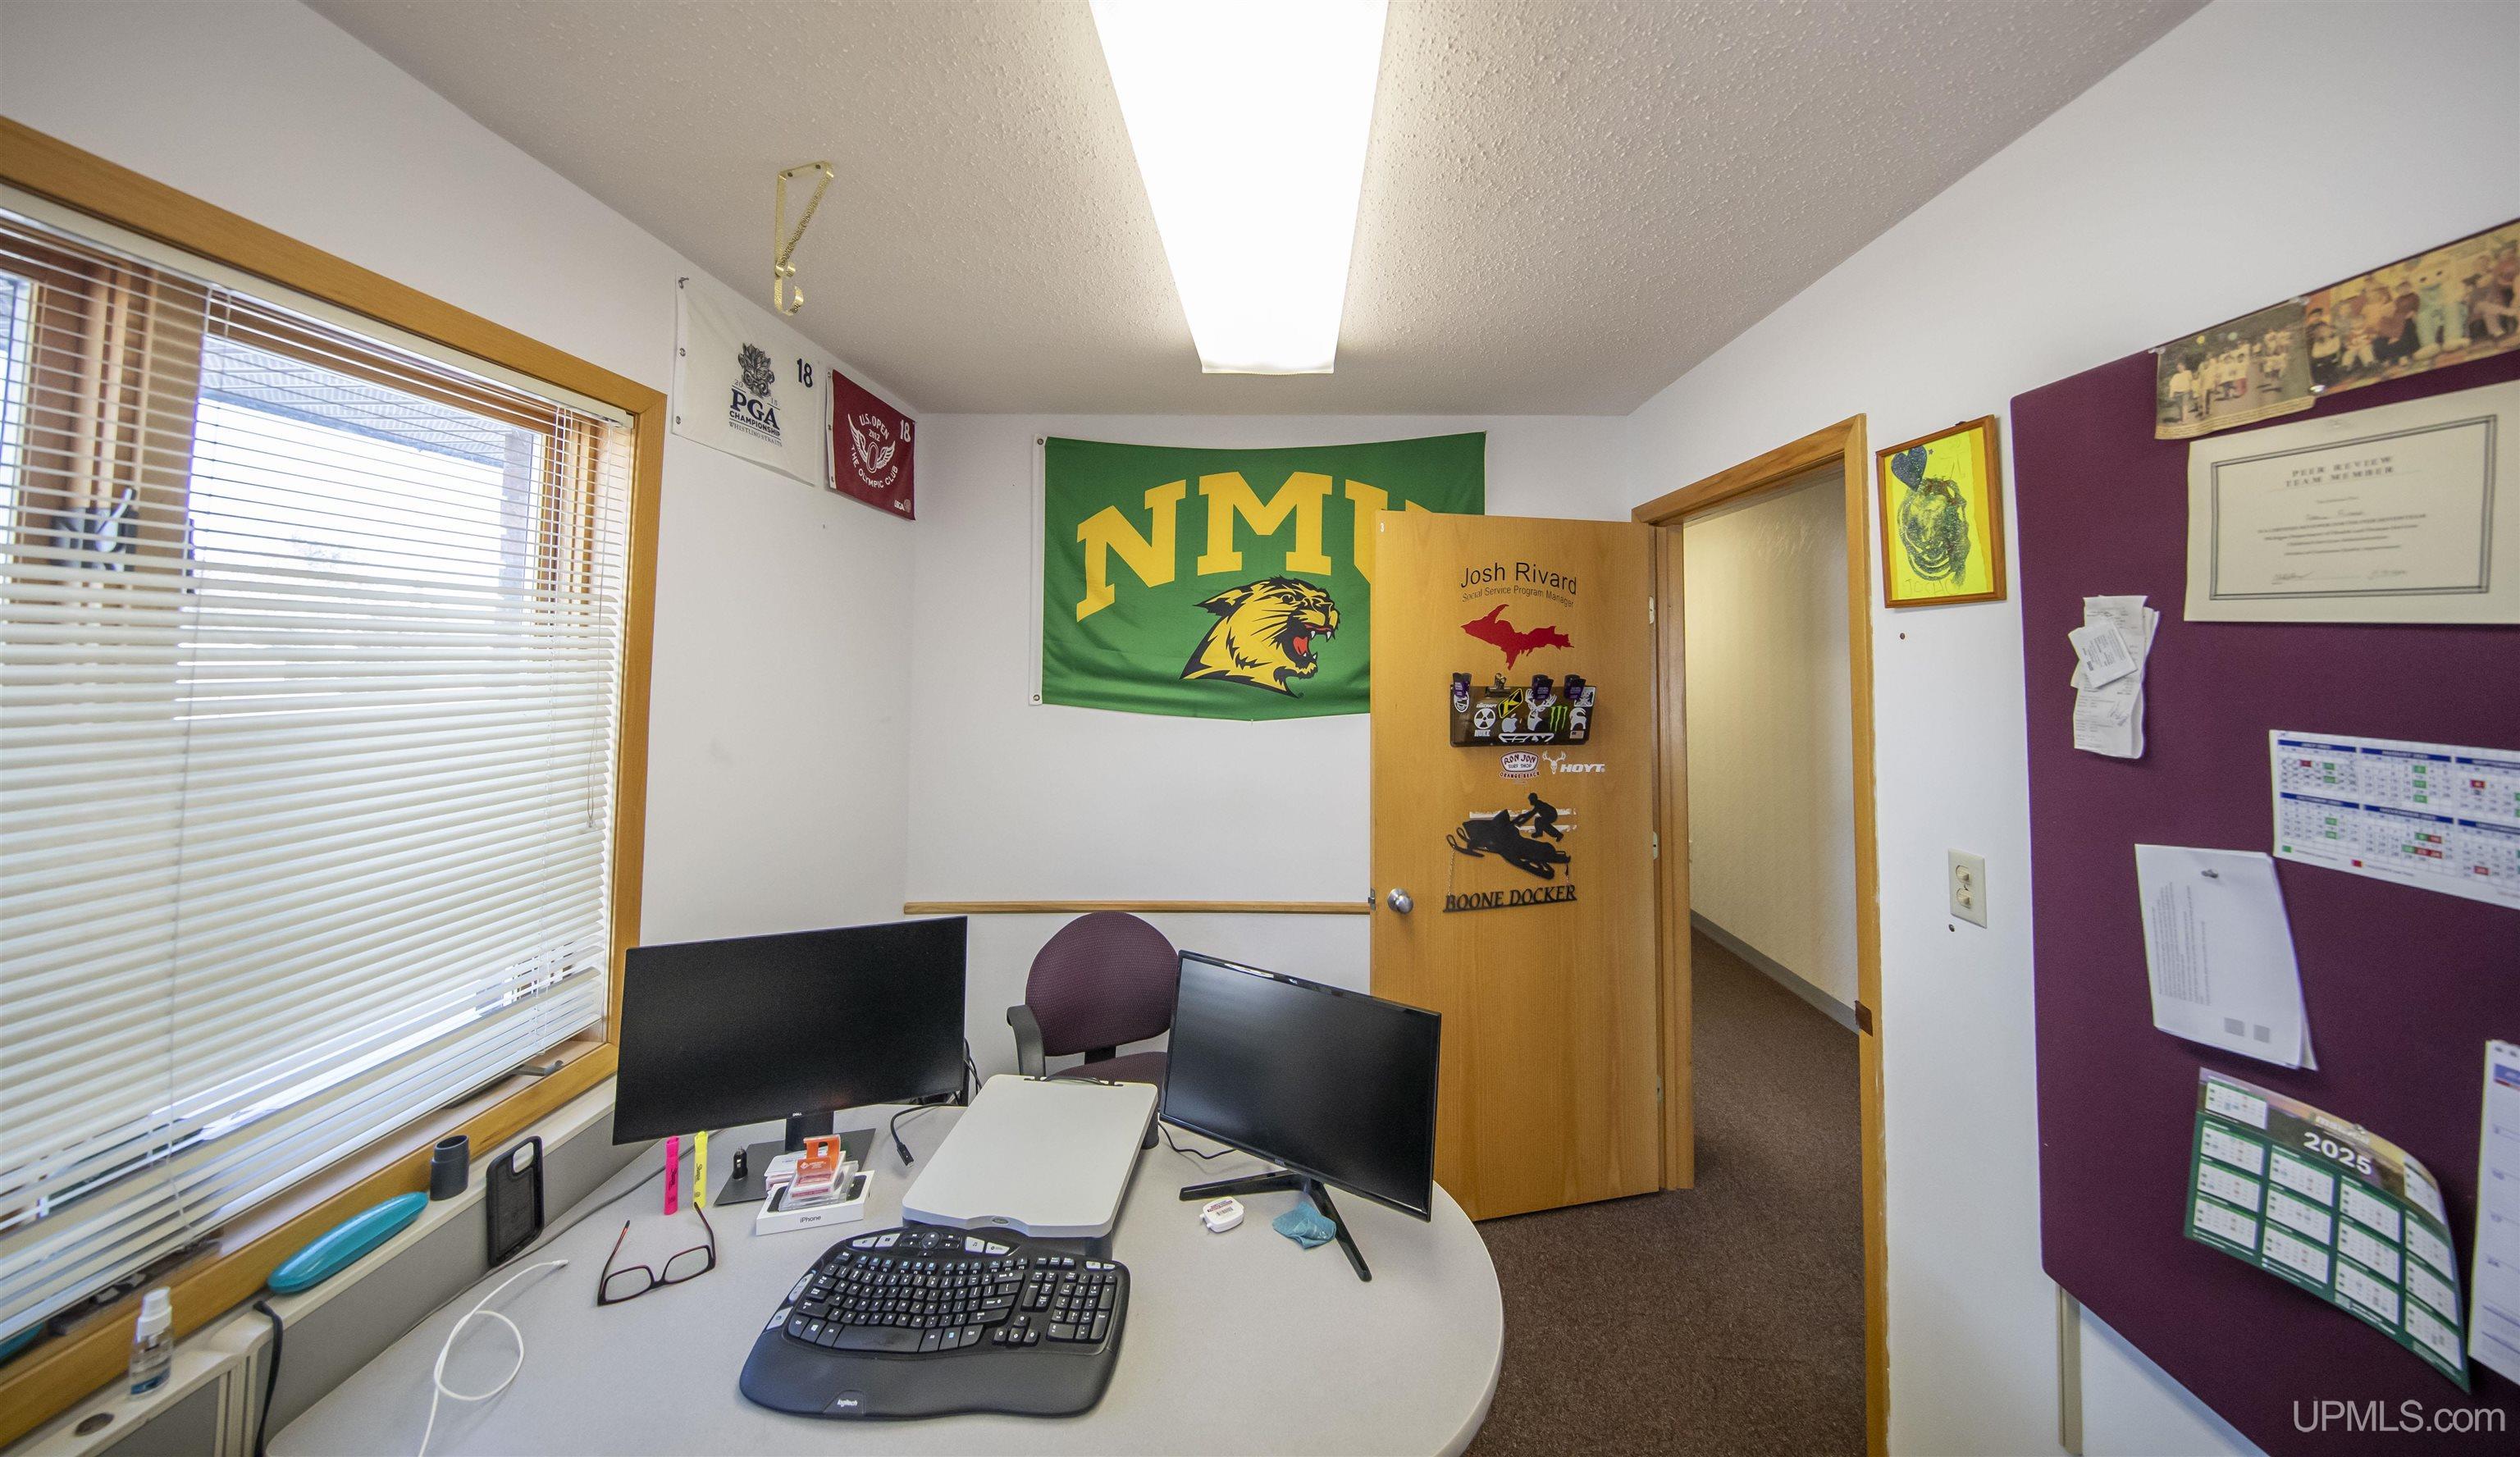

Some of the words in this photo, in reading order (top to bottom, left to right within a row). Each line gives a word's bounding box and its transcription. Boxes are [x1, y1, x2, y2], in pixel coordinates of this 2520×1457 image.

[797, 358, 813, 388] 18
[730, 388, 780, 431] PGA
[729, 411, 781, 436] CHAMPIONSHIP
[868, 428, 880, 442] 2012
[872, 416, 889, 441] OPEN
[900, 418, 911, 443] 18
[851, 444, 860, 468] THE
[2292, 467, 2325, 477] PEER
[2334, 456, 2392, 471] REVIEW
[858, 468, 884, 488] OLYMPIC
[885, 465, 898, 485] CLUB
[2286, 477, 2321, 487] TEAM
[2331, 466, 2394, 481] MEMBER
[1460, 562, 1506, 588] Josh
[1515, 562, 1577, 595] Rivard
[1462, 590, 1482, 602] Social
[1485, 587, 1511, 596] Service
[1513, 585, 1543, 597] Program
[1545, 590, 1574, 608] Manager
[1504, 754, 1520, 765] RON
[1521, 753, 1536, 764] JON
[1559, 764, 1605, 773] HOYT
[1445, 891, 1504, 910] BOONE
[1509, 884, 1577, 907] DOCKER
[2303, 1131, 2372, 1176] 2025
[800, 1215, 822, 1223] iPhone
[837, 1399, 858, 1407] logitech
